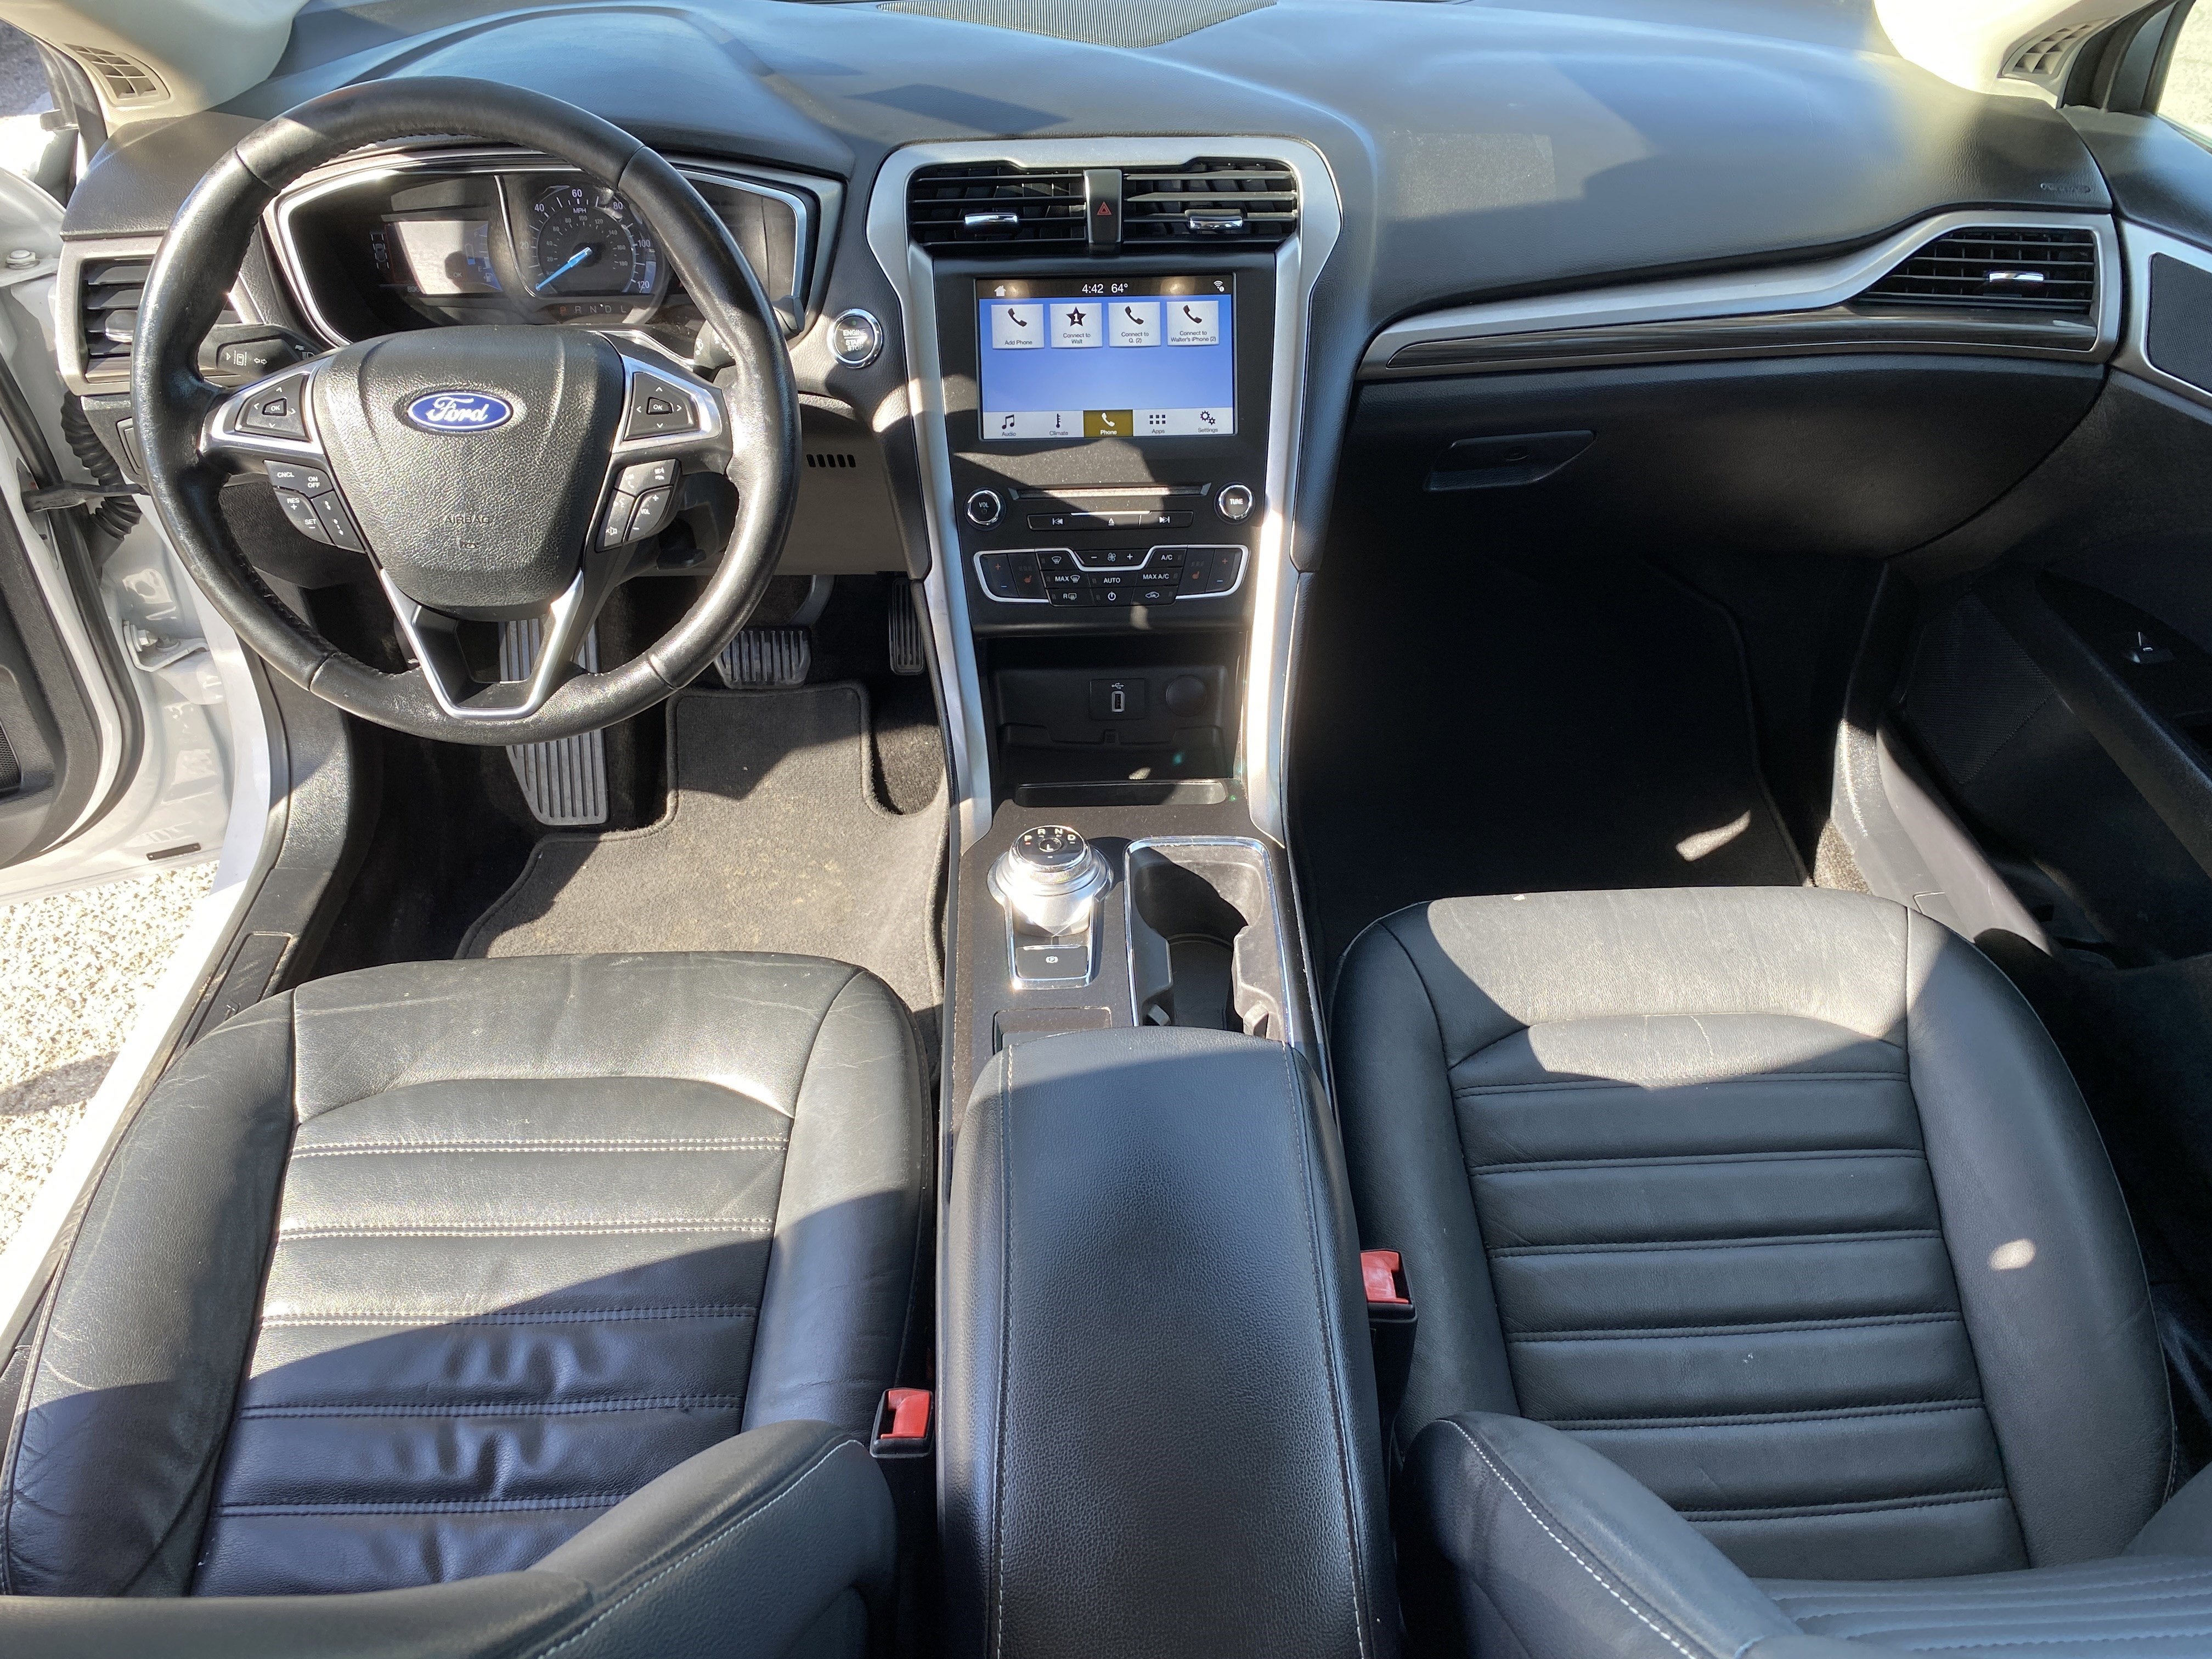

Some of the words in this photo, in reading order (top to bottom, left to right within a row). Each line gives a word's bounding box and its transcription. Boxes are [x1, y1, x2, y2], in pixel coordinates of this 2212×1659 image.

[572, 189, 582, 198] 60
[534, 204, 545, 212] 40
[613, 201, 623, 210] 80
[520, 241, 529, 250] 20
[637, 239, 651, 247] 100
[637, 280, 650, 289] 120
[1082, 284, 1104, 294] 4:42
[560, 306, 566, 314] P
[574, 306, 581, 314] R
[605, 305, 612, 313] D
[426, 396, 489, 422] Ford
